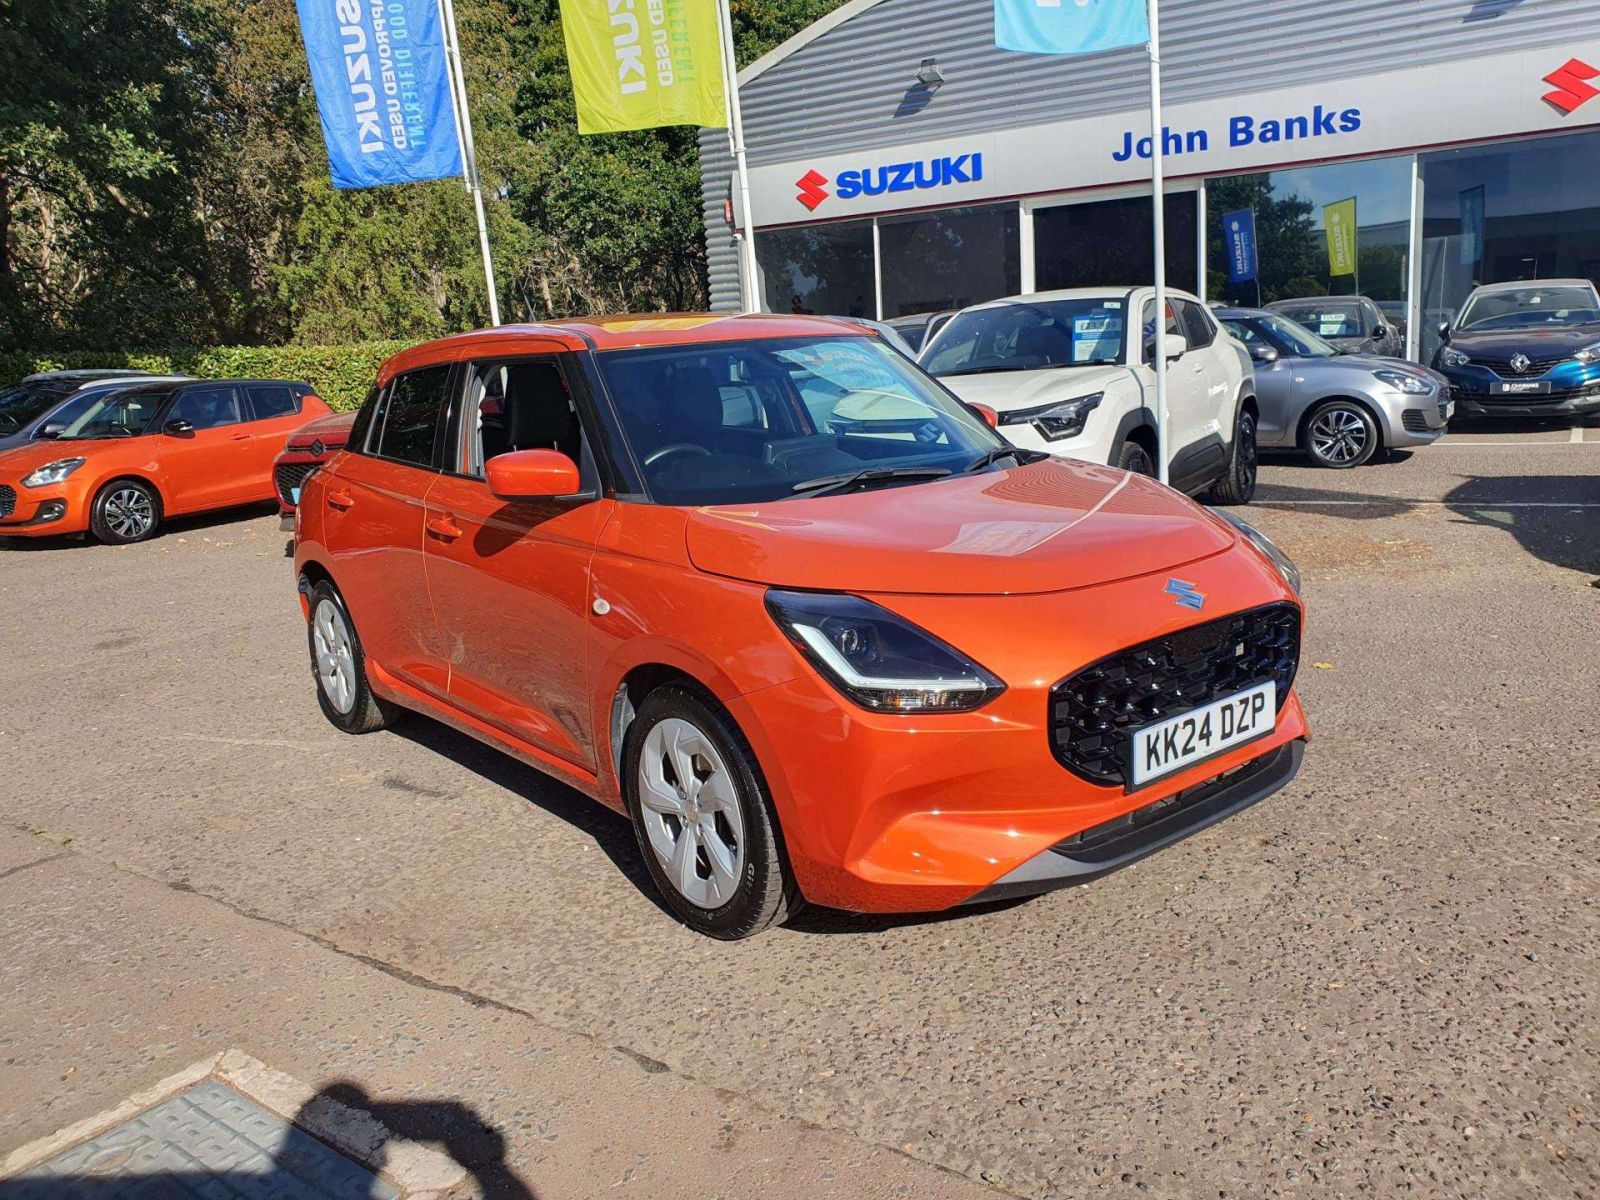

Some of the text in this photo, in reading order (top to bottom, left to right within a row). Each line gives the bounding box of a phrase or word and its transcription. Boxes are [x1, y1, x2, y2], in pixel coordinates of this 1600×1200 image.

[1112, 105, 1362, 162] John Banks
[836, 153, 982, 199] SUZUKI
[1146, 691, 1265, 771] KK24 DZP
